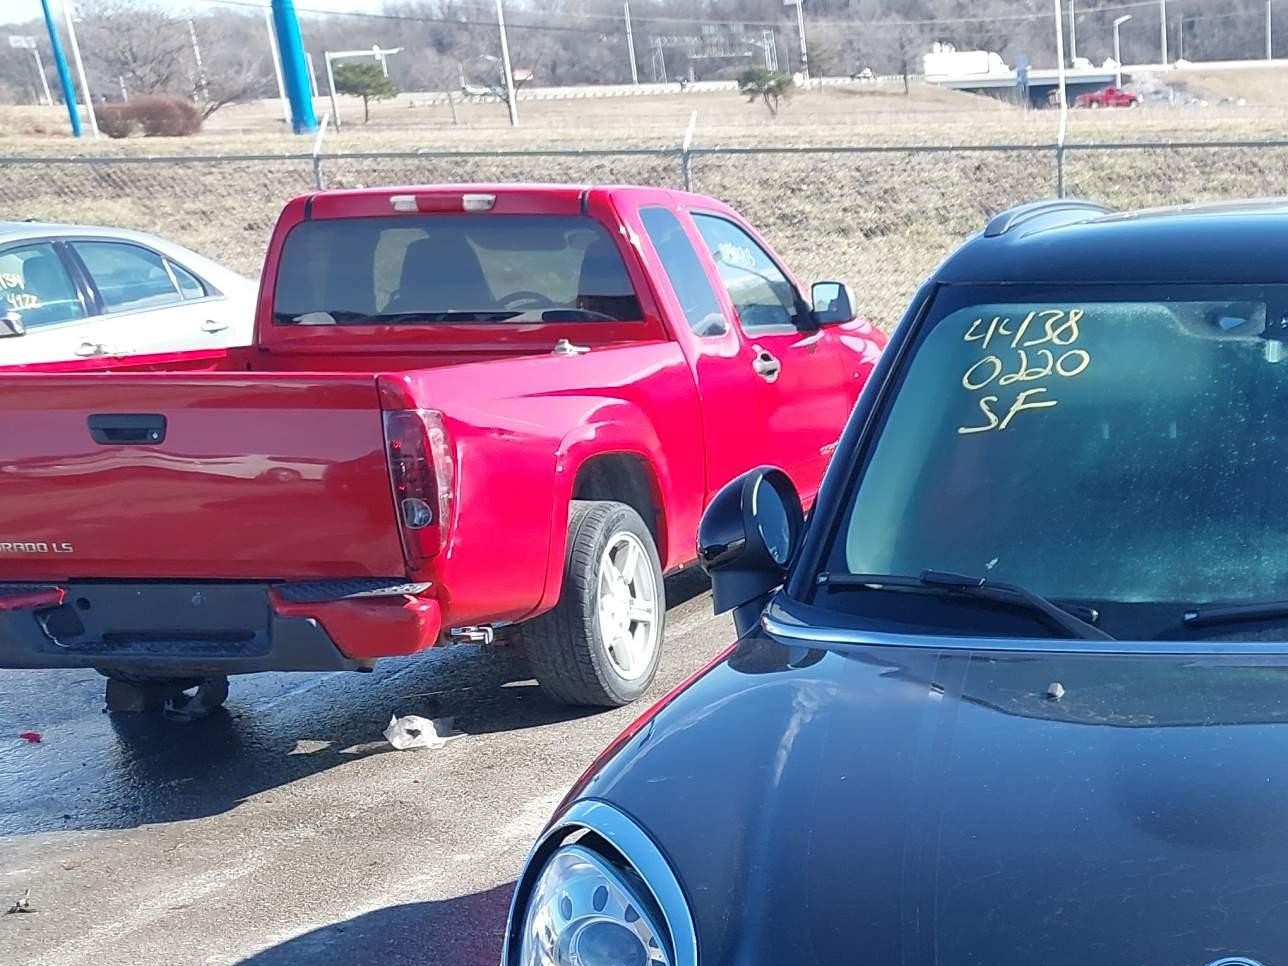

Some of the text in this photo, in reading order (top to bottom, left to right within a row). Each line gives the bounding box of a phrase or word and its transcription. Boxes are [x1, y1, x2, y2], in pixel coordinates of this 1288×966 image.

[963, 308, 1084, 349] 4438
[962, 349, 1091, 390] 0220
[958, 387, 1058, 434] SF
[0, 542, 74, 553] RADO LS
